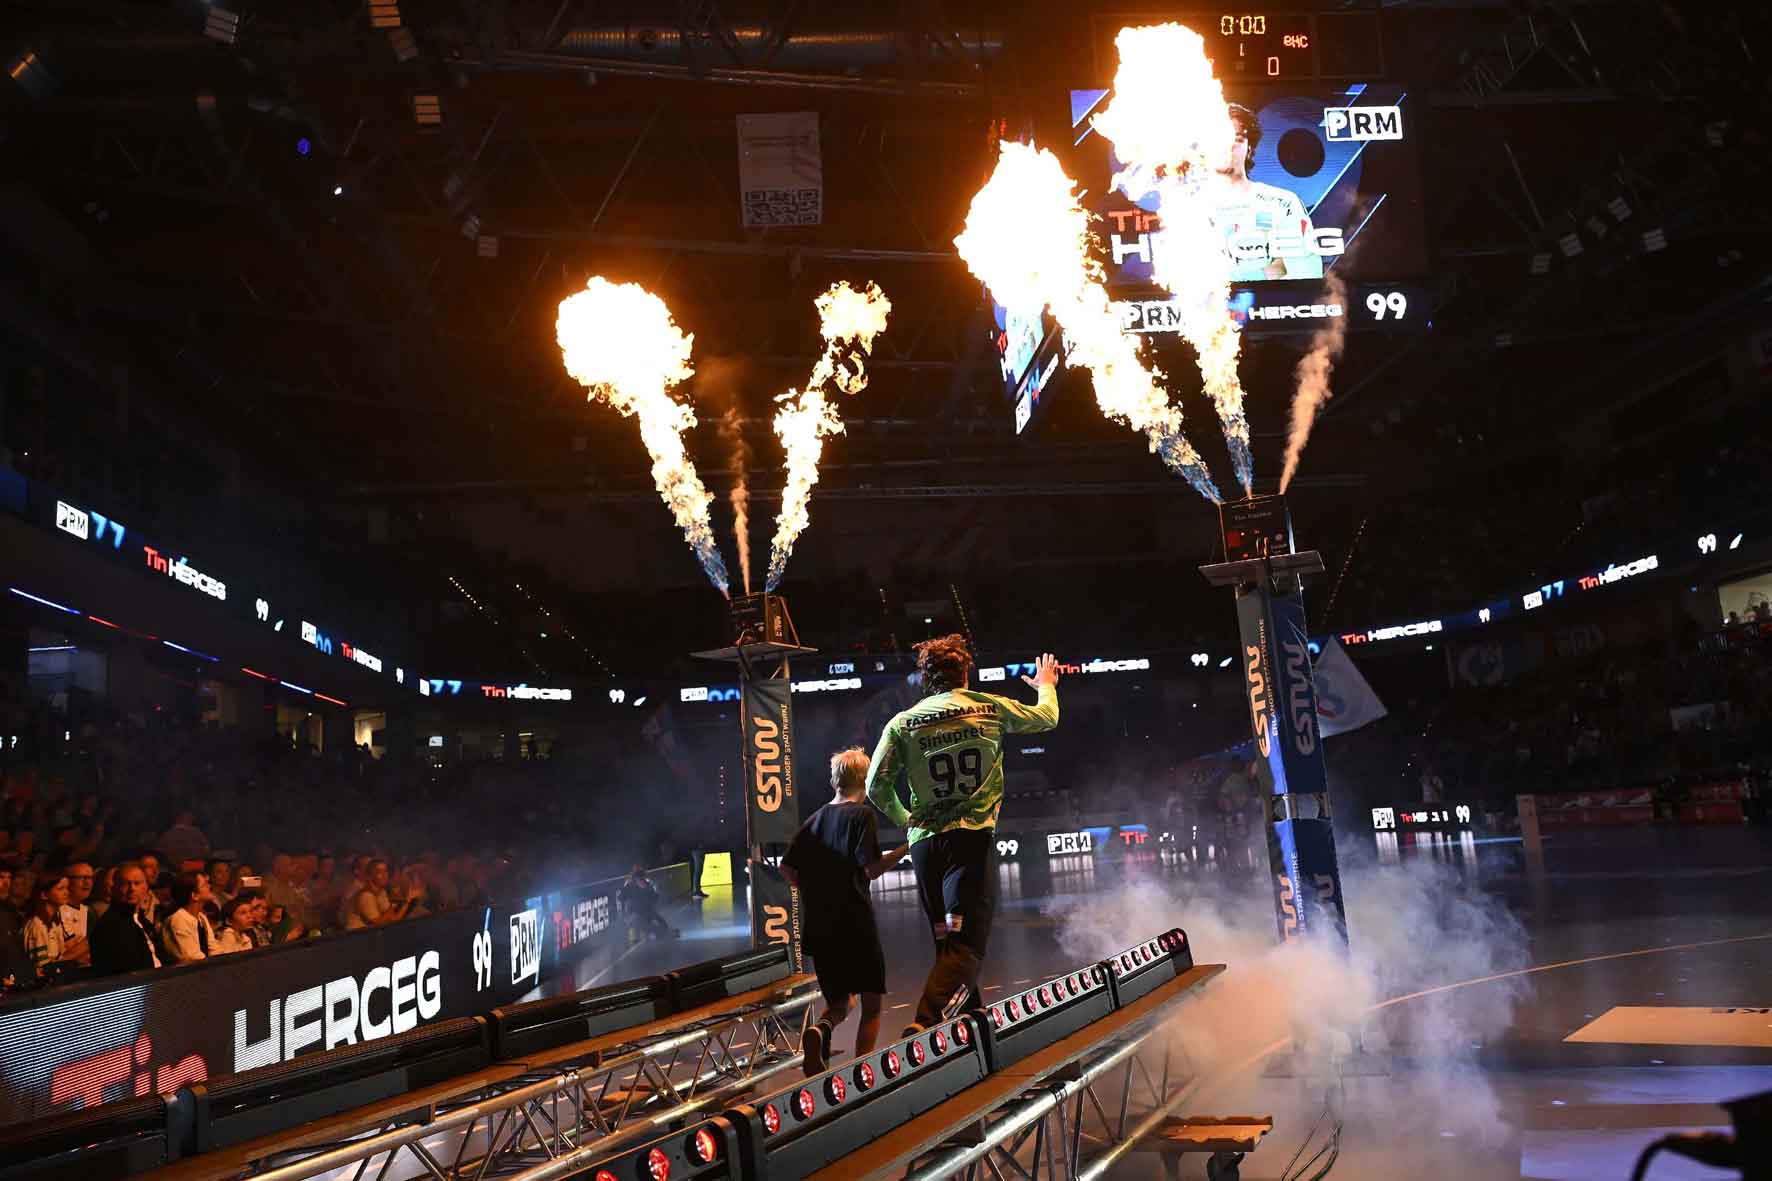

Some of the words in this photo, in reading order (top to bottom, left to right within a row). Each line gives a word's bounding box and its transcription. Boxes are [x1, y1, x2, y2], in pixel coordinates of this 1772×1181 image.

[1267, 56, 1279, 76] 0
[1325, 107, 1402, 140] PRM
[1248, 304, 1343, 321] HERCEG
[1366, 292, 1407, 320] 99
[57, 502, 88, 539] PRM
[144, 545, 168, 574] Tin
[168, 557, 227, 601] HERCEG
[1578, 575, 1600, 591] Tin
[1342, 633, 1367, 646] Tin
[482, 685, 505, 698] Tin
[1247, 645, 1271, 758] ESTW
[753, 716, 782, 813] ESTW
[928, 748, 982, 798] 99
[997, 839, 1018, 855] 99
[573, 895, 609, 944] HERCEG
[473, 931, 492, 992] 99
